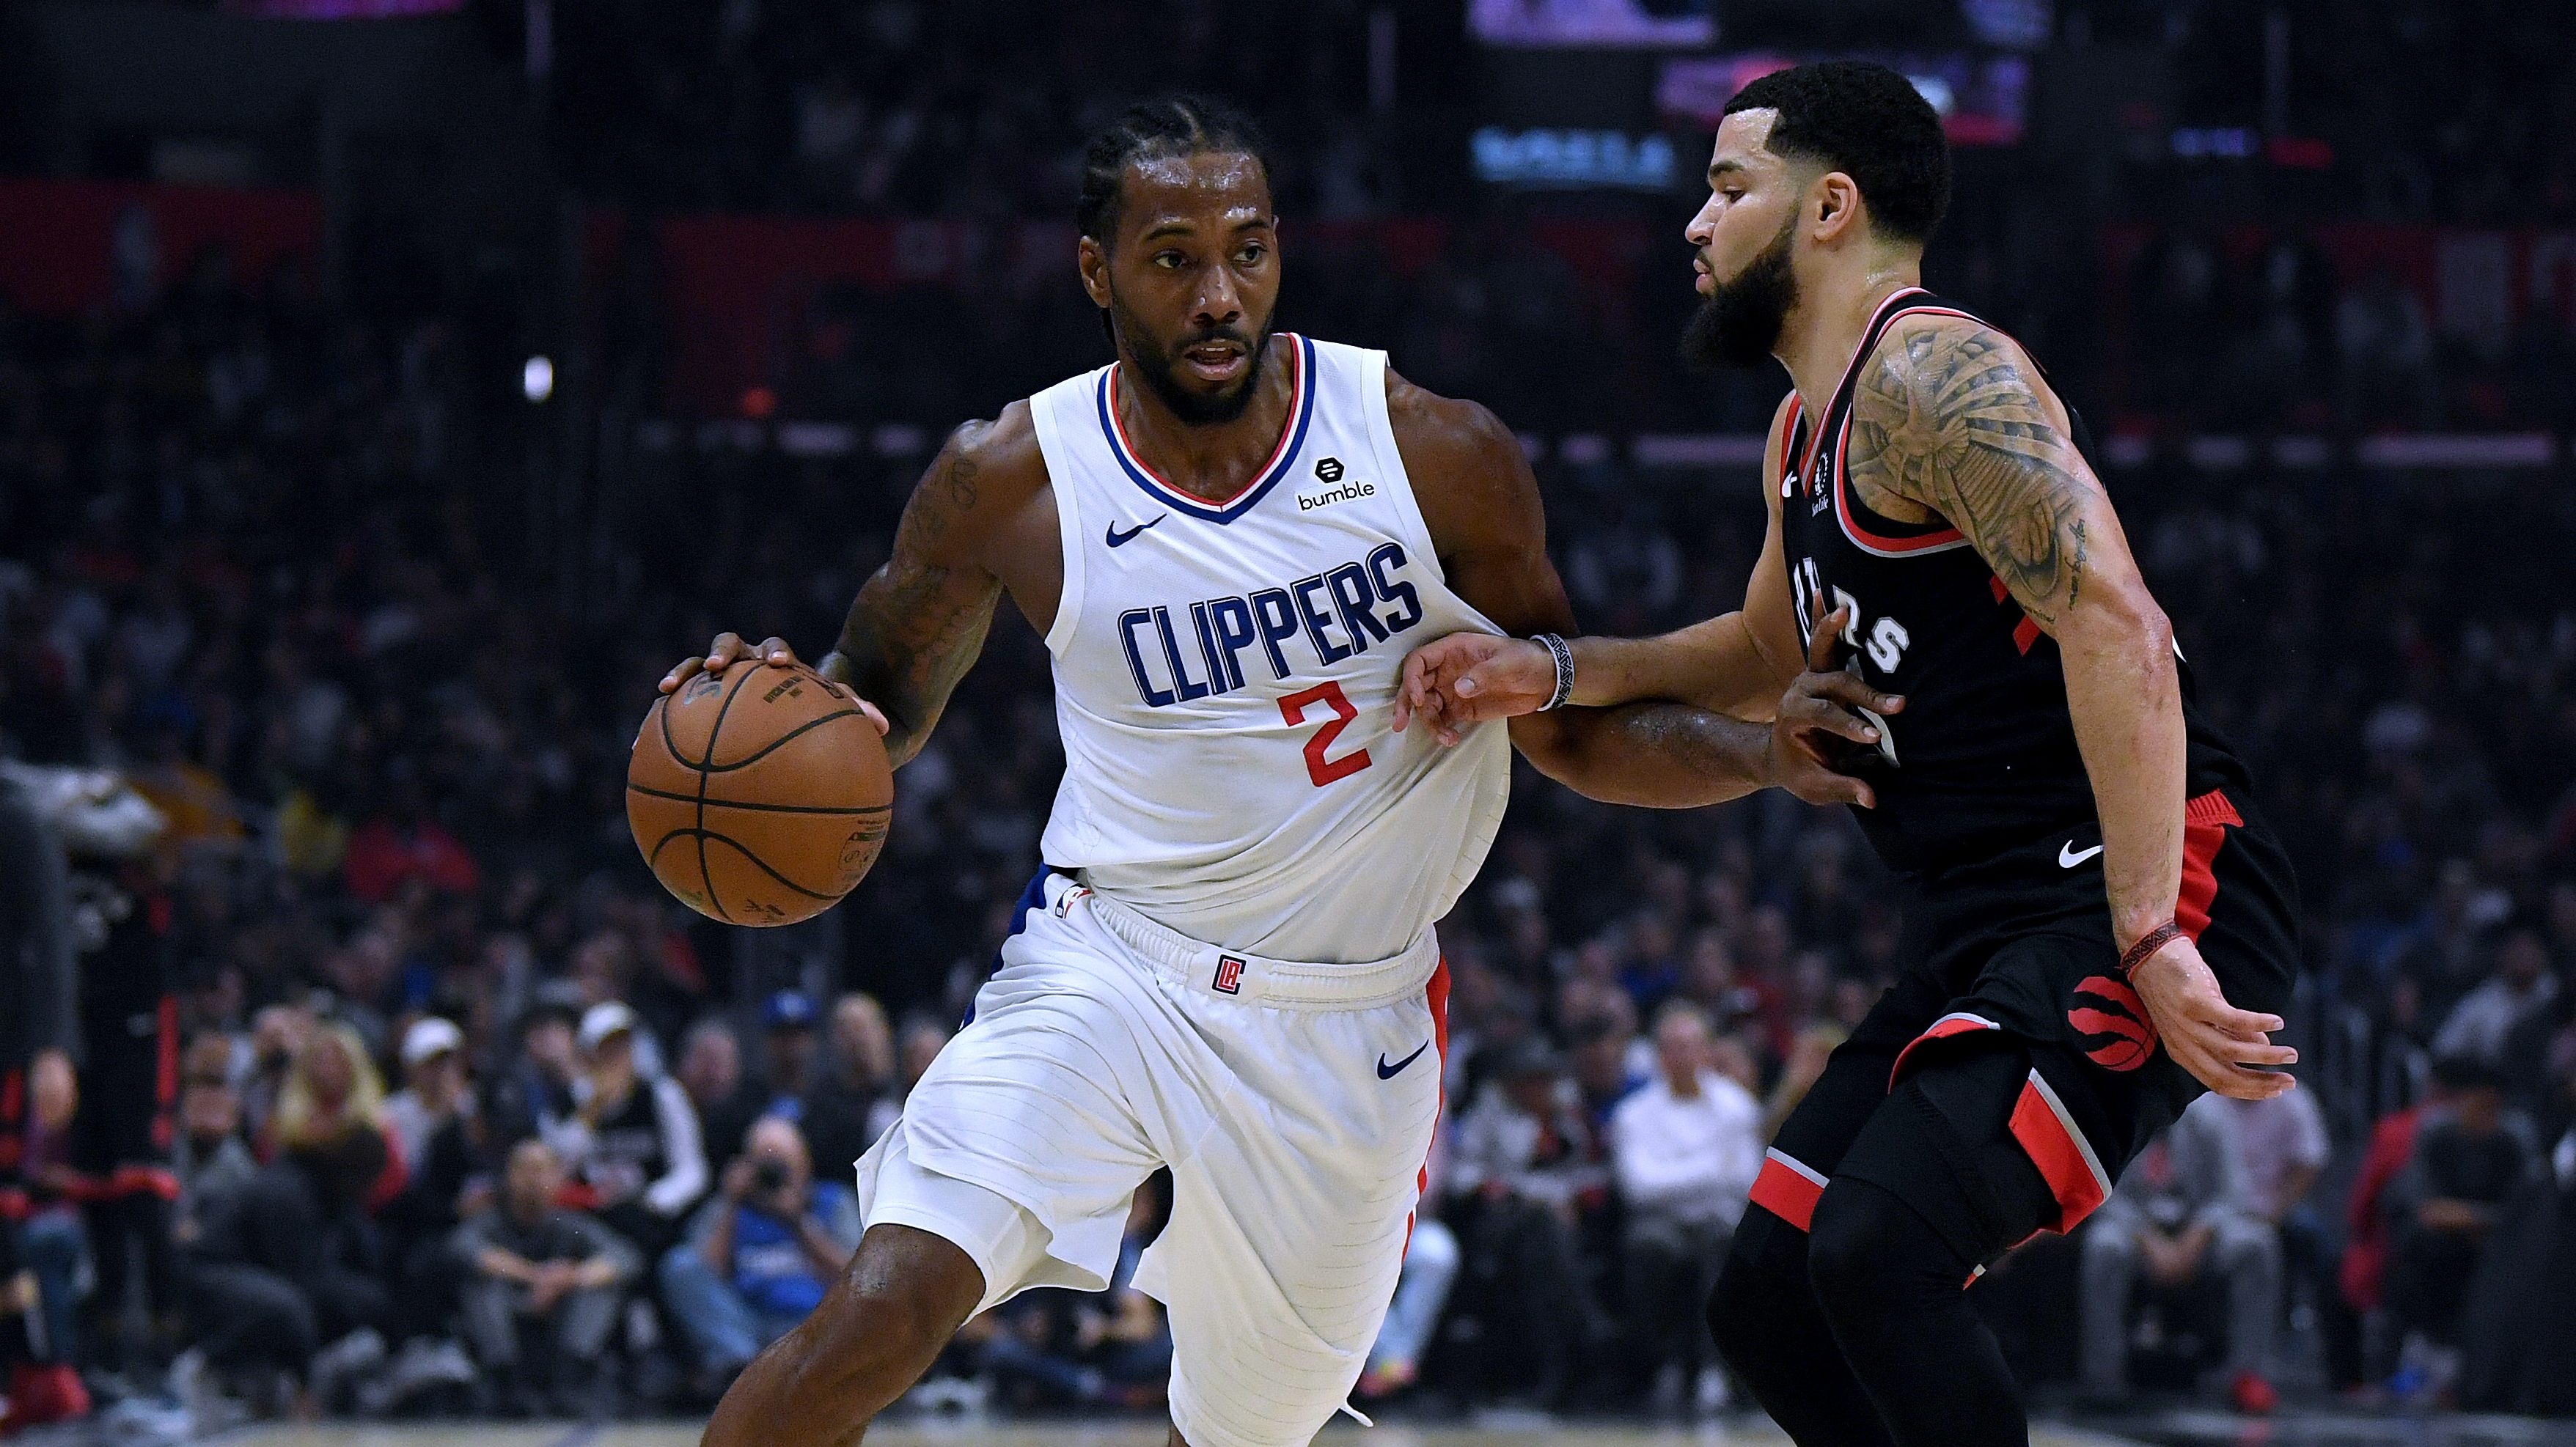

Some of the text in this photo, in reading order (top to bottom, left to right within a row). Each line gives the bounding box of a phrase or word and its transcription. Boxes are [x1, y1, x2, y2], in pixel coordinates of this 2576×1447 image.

[1298, 481, 1375, 511] bumble
[1117, 542, 1423, 708] CLIPPERS
[1276, 680, 1373, 787] 2
